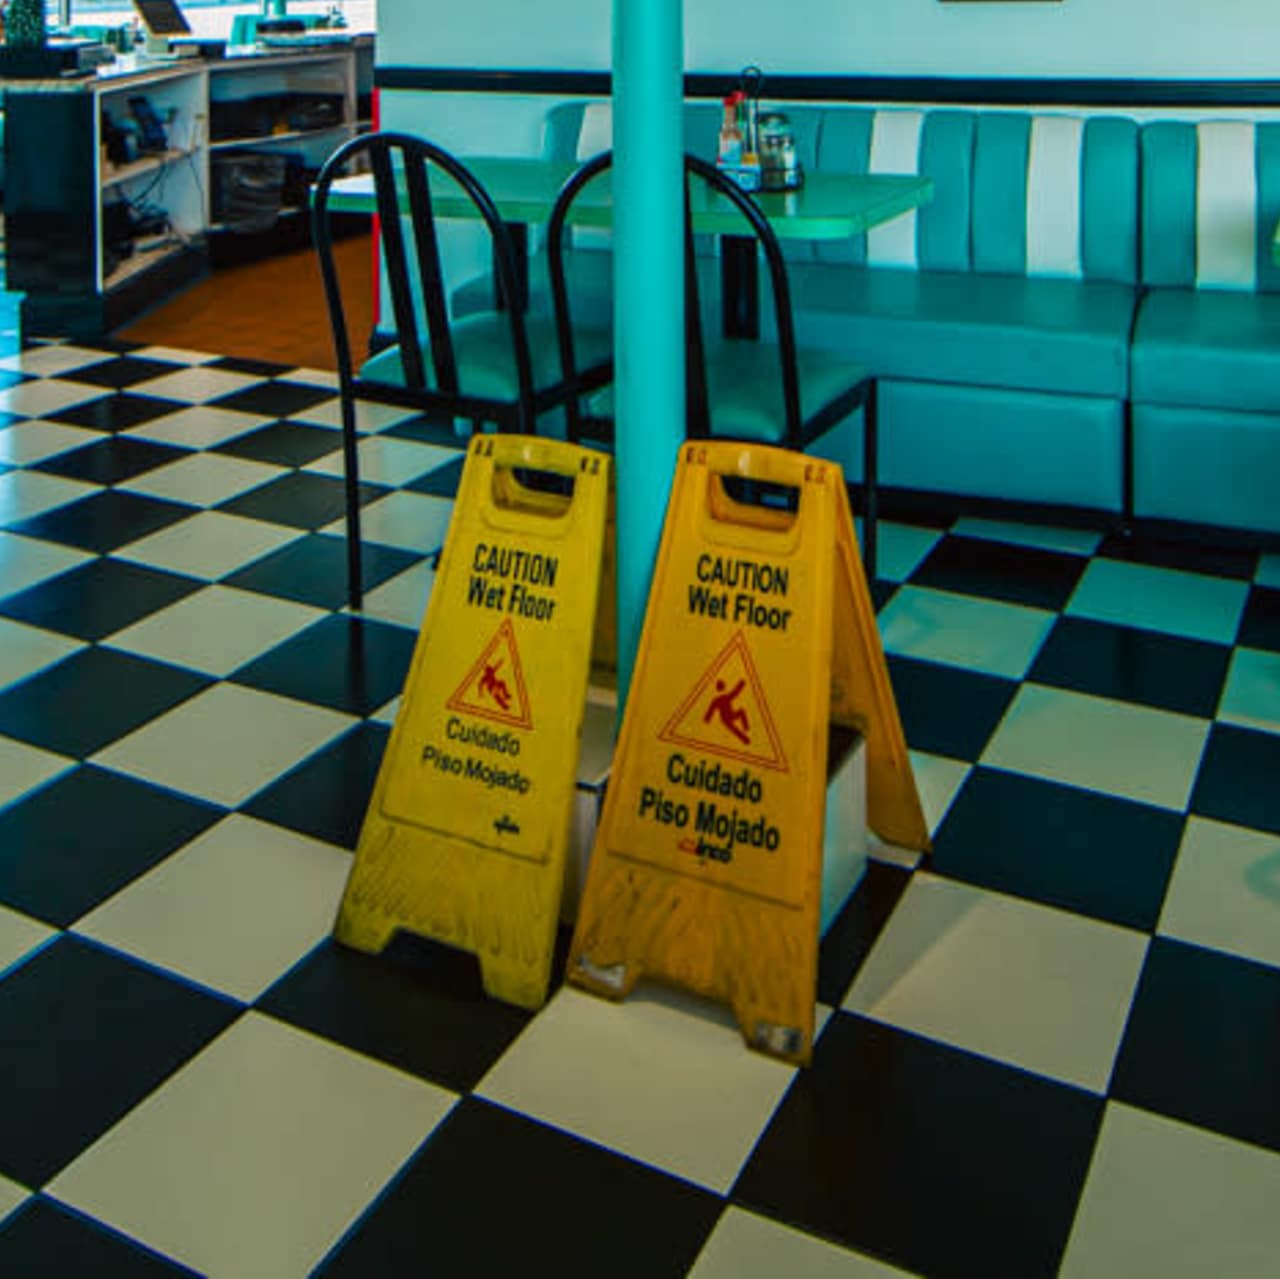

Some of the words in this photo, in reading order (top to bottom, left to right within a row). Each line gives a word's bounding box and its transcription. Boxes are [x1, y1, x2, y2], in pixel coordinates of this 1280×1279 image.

[473, 543, 558, 587] CAUTION
[697, 553, 789, 596] CAUTION
[467, 574, 505, 611] Wet
[508, 583, 556, 622] Floor
[688, 585, 729, 621] Wet
[734, 594, 793, 631] Floor
[446, 717, 520, 756] Cuidado
[422, 745, 463, 774] Piso
[464, 757, 530, 794] Mojado
[667, 753, 762, 803] Cuidado
[638, 787, 689, 828] Piso
[694, 800, 780, 851] Mojado
